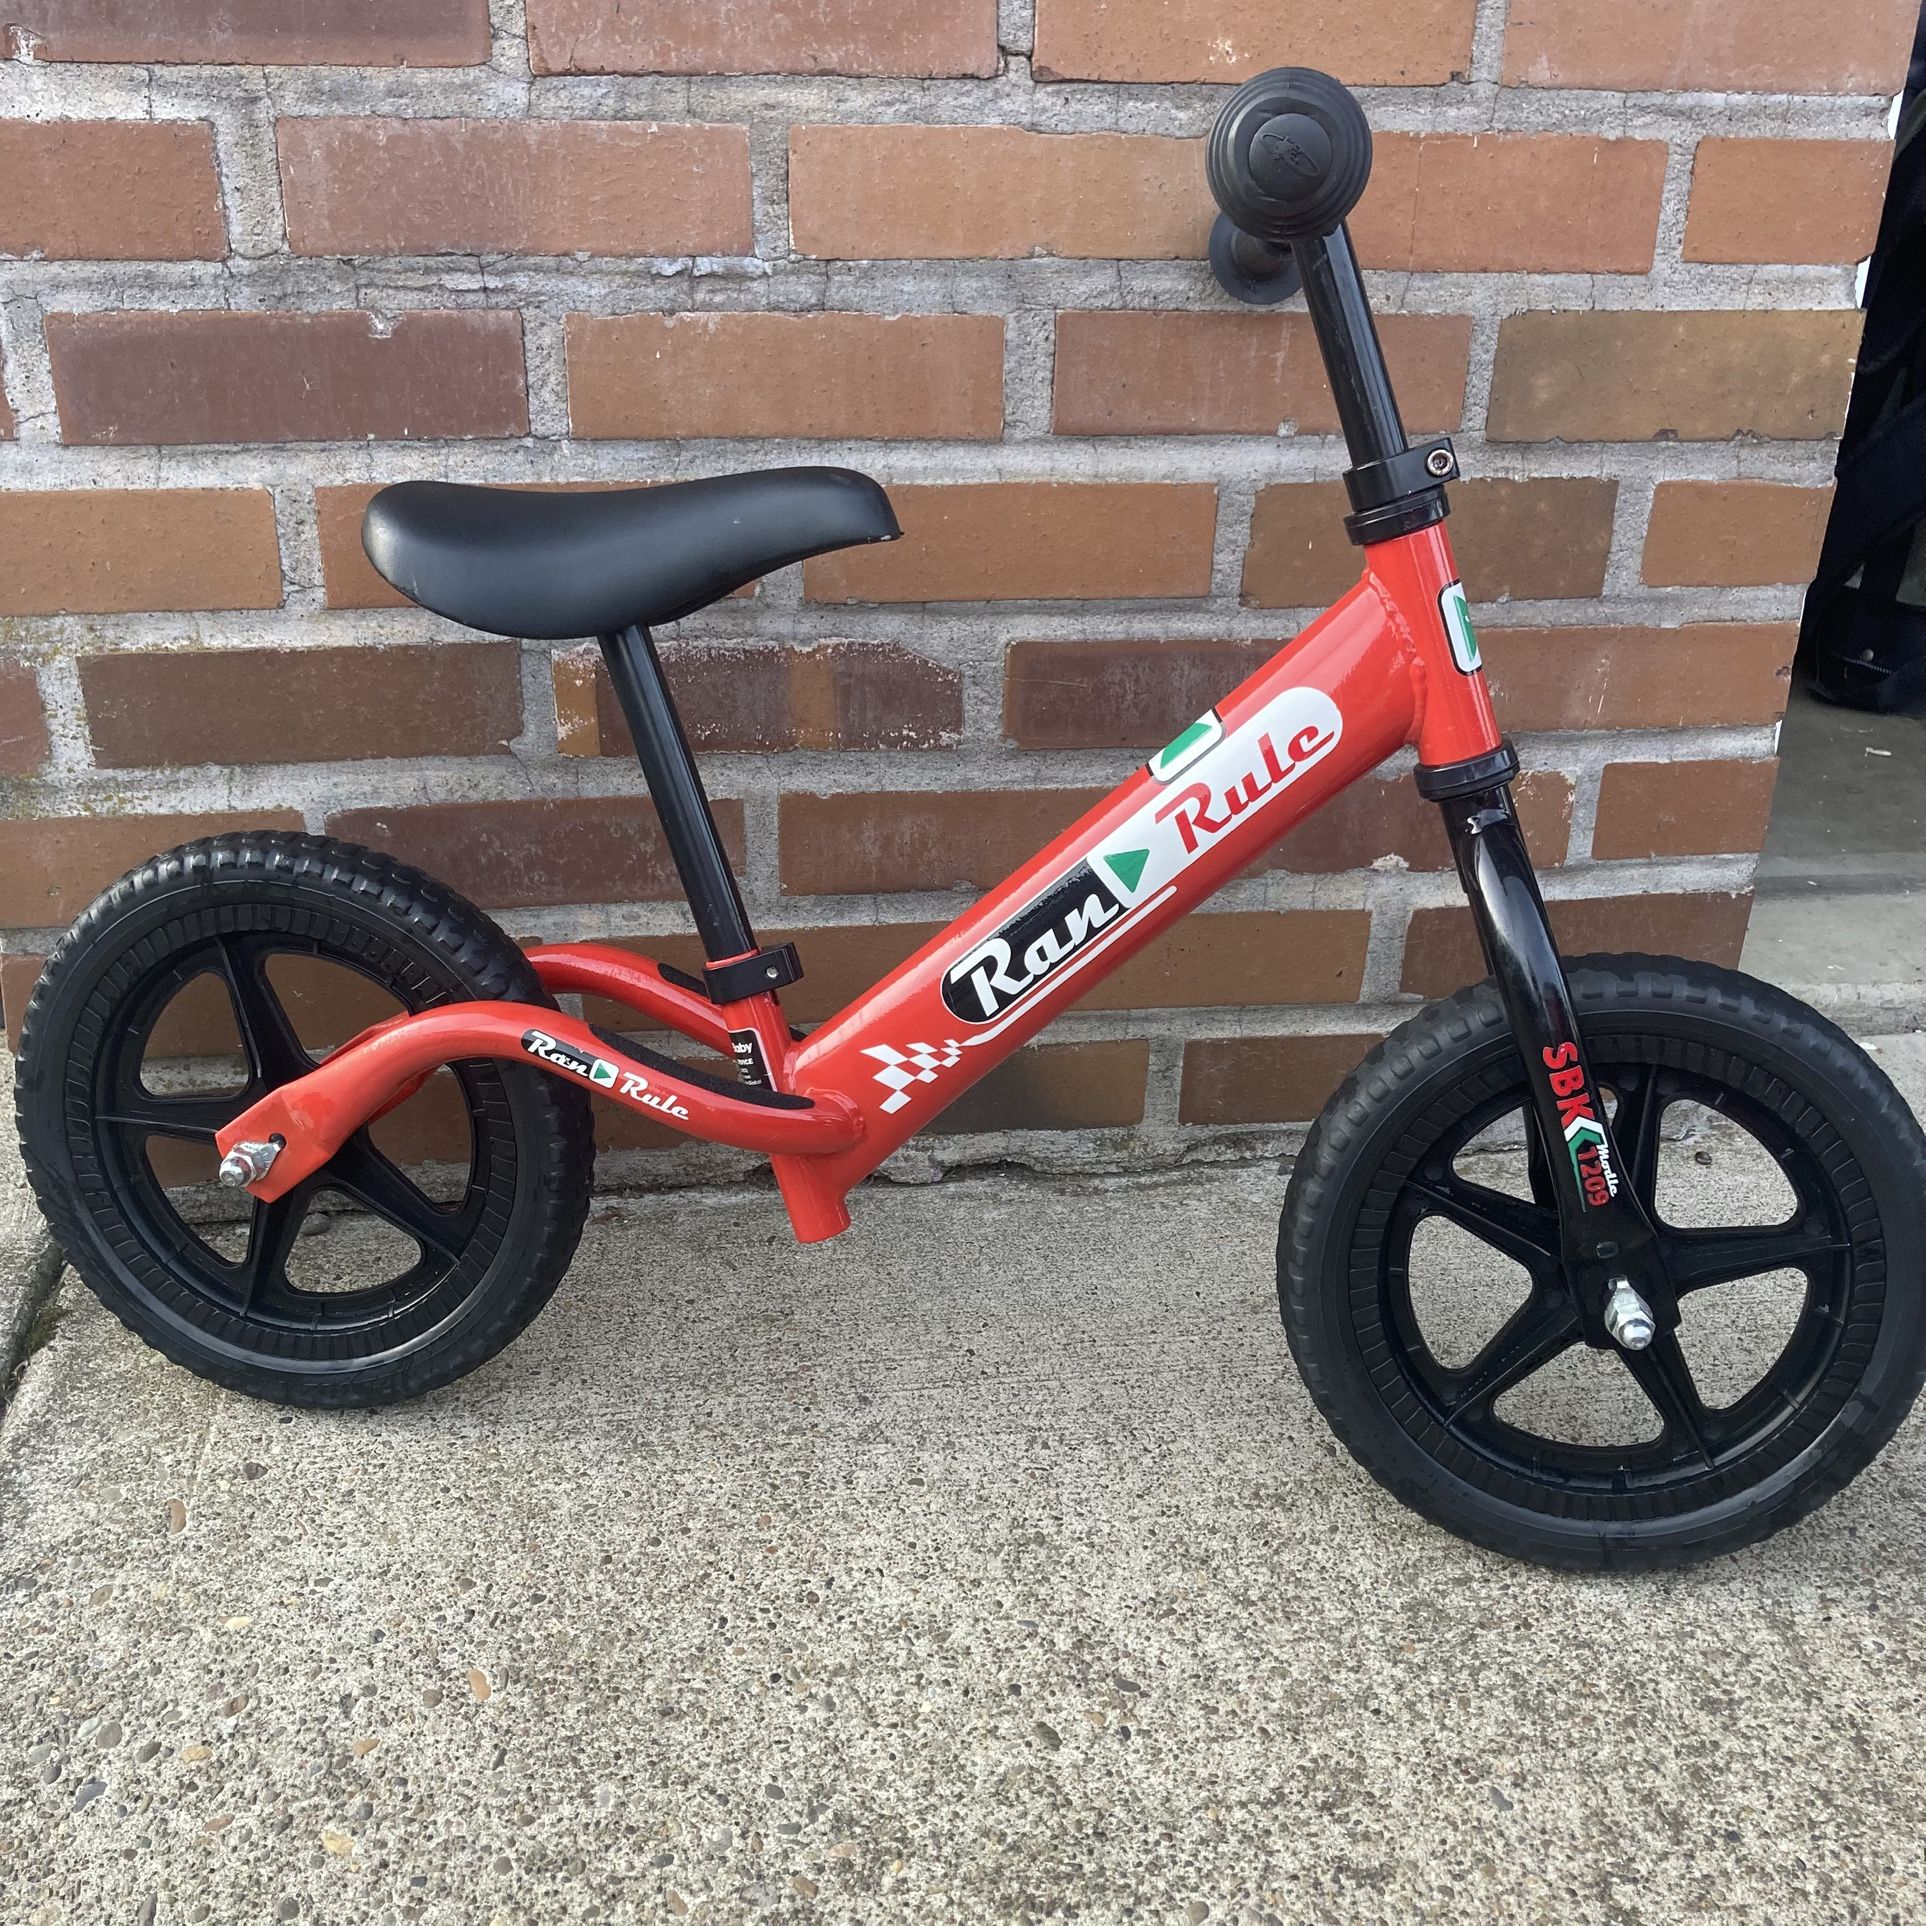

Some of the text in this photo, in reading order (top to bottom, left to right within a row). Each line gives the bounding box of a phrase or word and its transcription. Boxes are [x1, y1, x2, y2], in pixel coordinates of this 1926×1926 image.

[950, 725, 1335, 1018] Ran Rule
[527, 1030, 689, 1121] Ran Rule
[731, 1042, 753, 1054] aby
[1542, 1041, 1596, 1130] SBK
[1577, 1145, 1610, 1207] 1209
